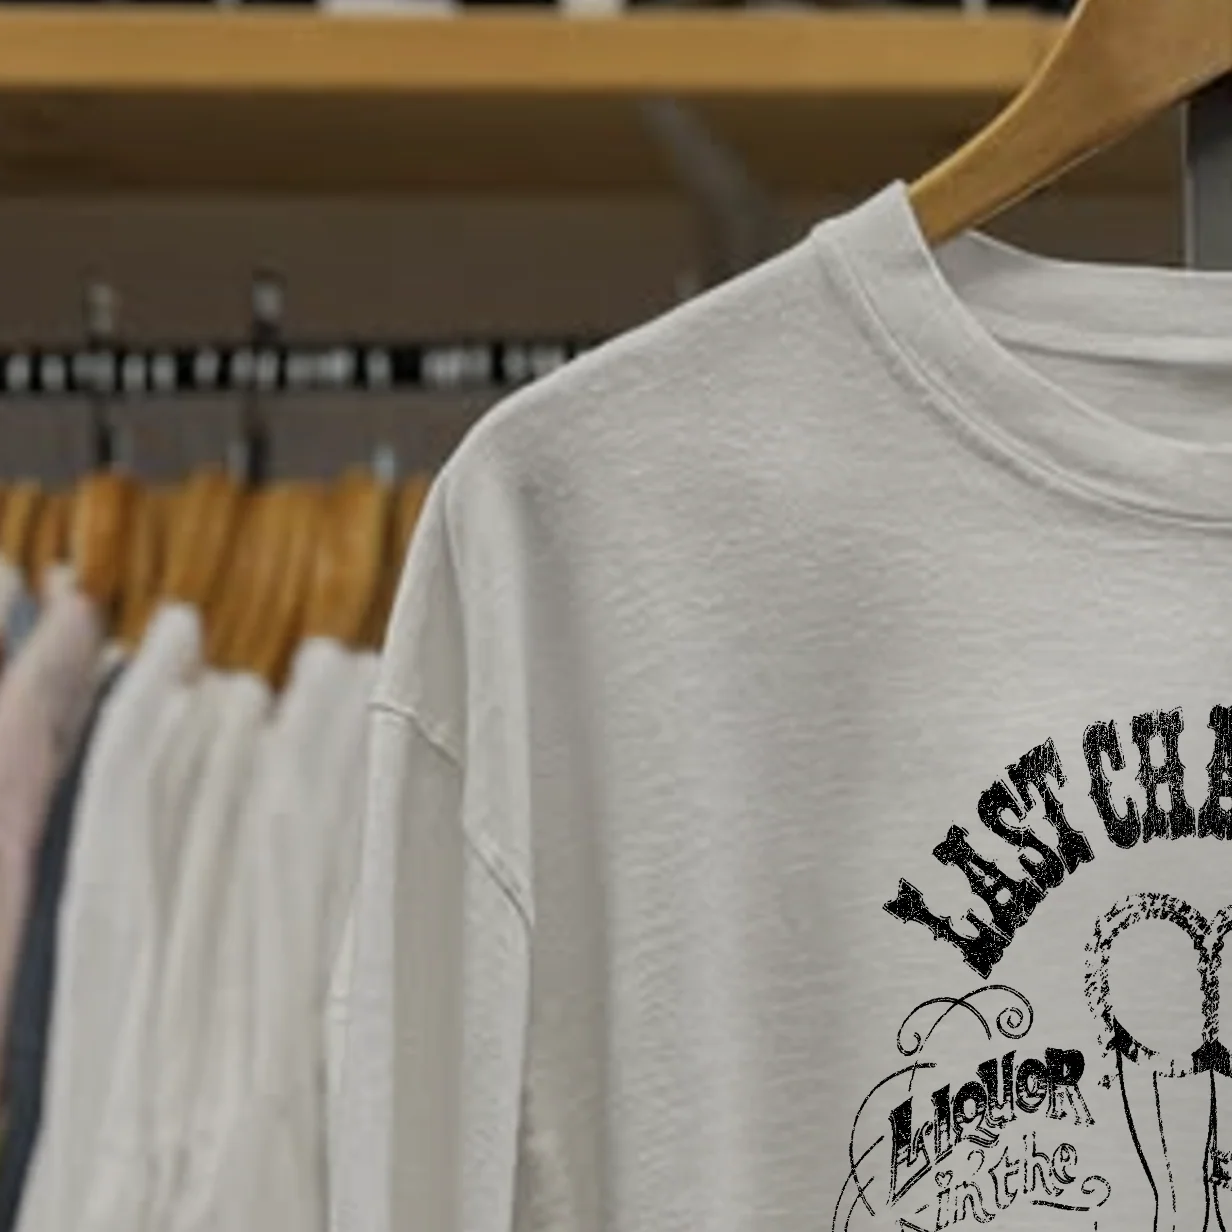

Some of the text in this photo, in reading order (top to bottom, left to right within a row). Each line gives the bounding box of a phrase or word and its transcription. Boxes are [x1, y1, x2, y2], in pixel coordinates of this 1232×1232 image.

[882, 737, 1095, 979] LAST
[887, 1047, 1096, 1207] LIQUOR
[988, 1131, 1079, 1210] the
